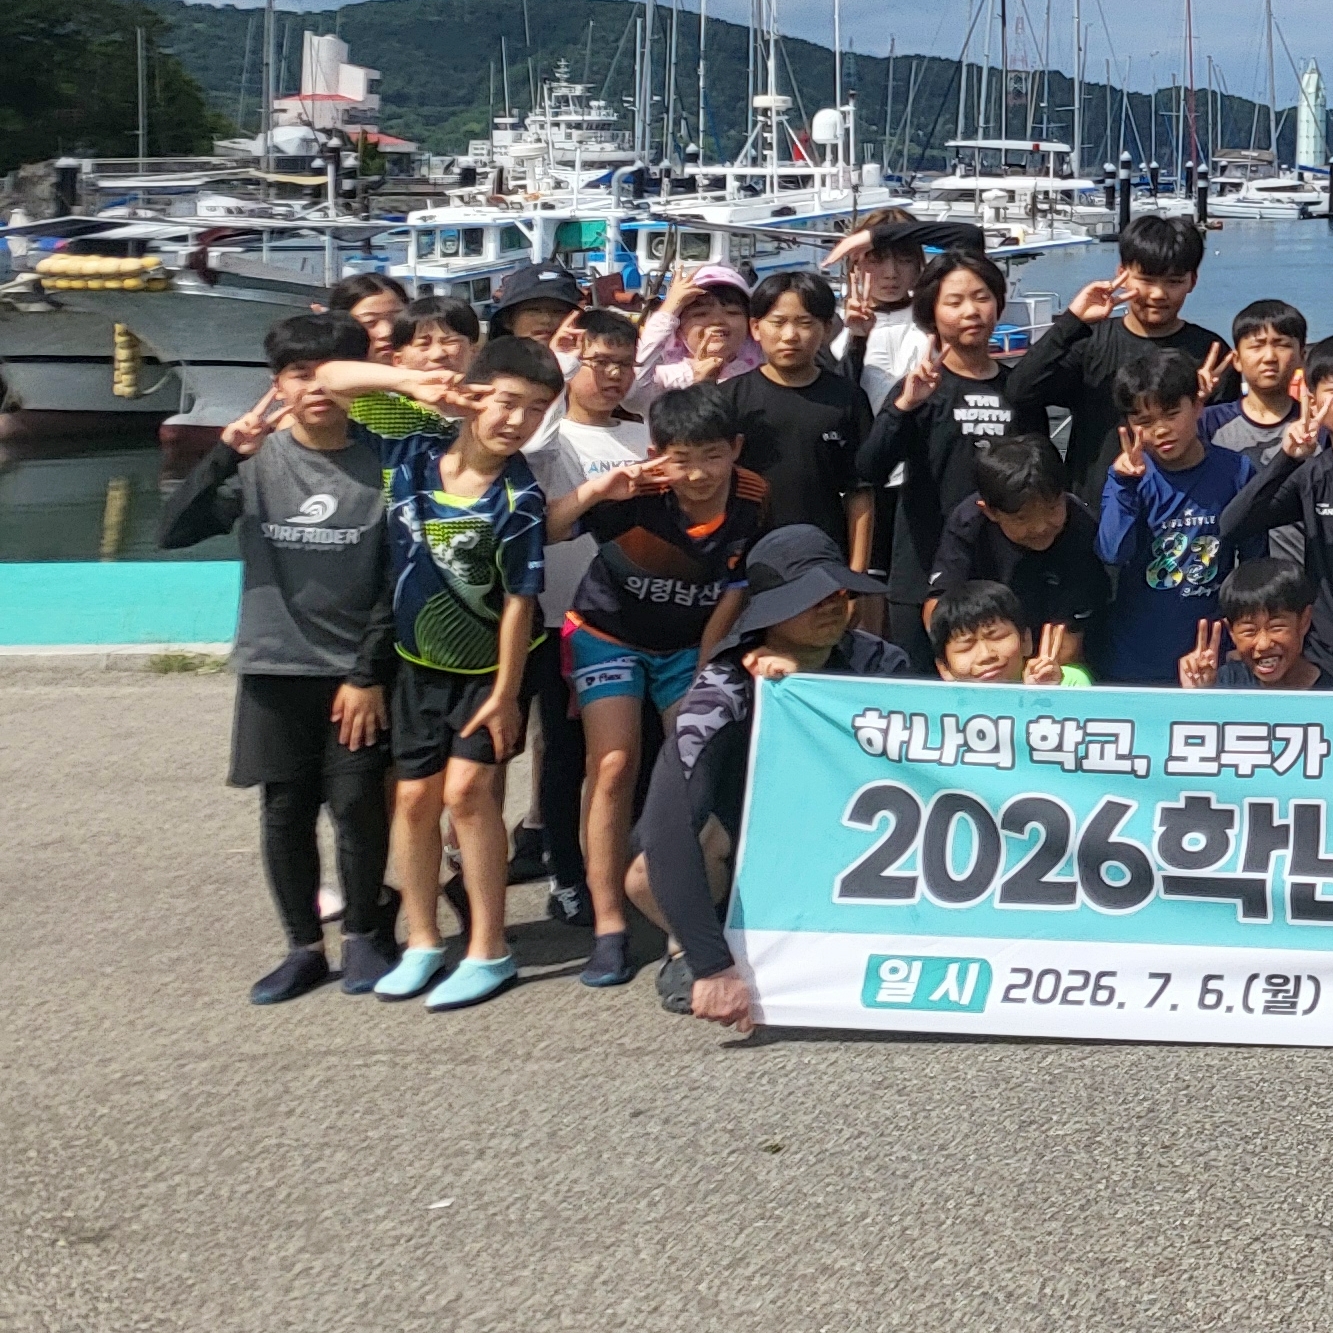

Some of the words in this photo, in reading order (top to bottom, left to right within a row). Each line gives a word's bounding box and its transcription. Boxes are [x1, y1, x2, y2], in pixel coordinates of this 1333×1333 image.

[953, 408, 1011, 422] NORTH
[1146, 532, 1220, 590] 83
[624, 576, 721, 606] 의령남산
[852, 707, 1016, 770] 하나의
[1026, 715, 1151, 779] 학교,
[1165, 721, 1331, 780] 모두가
[1000, 967, 1127, 1010] 2026.
[1144, 973, 1178, 1012] 7.
[1198, 972, 1322, 1016] 6.(월)
